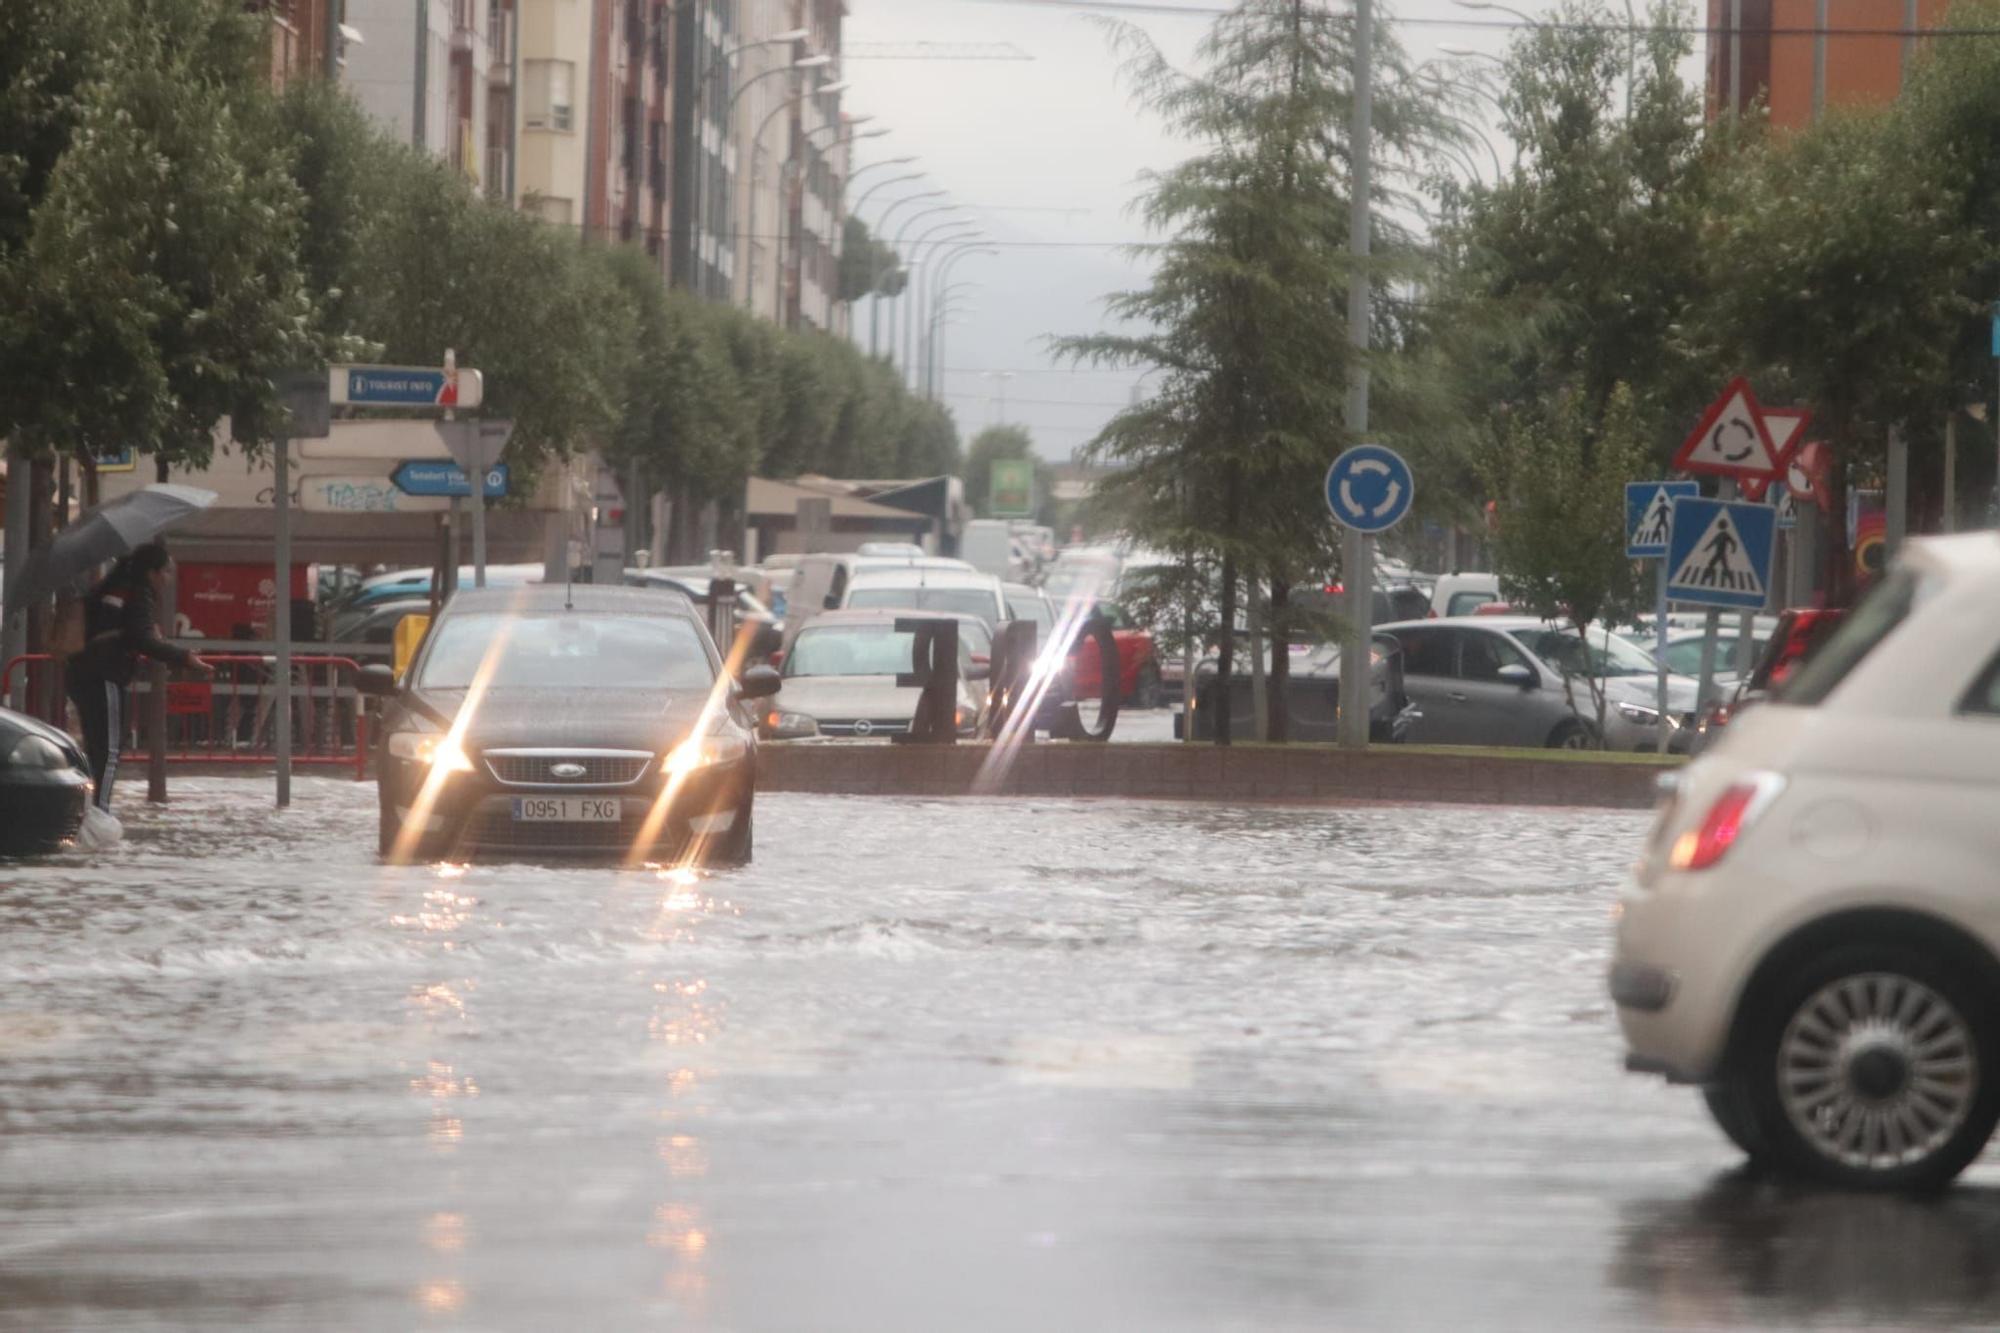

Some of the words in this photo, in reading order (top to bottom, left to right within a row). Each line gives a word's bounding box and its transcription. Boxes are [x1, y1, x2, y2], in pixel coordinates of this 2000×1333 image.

[369, 379, 409, 391] TOURIST
[410, 381, 433, 392] INFO
[525, 800, 567, 818] 0951
[581, 800, 615, 818] FXG
